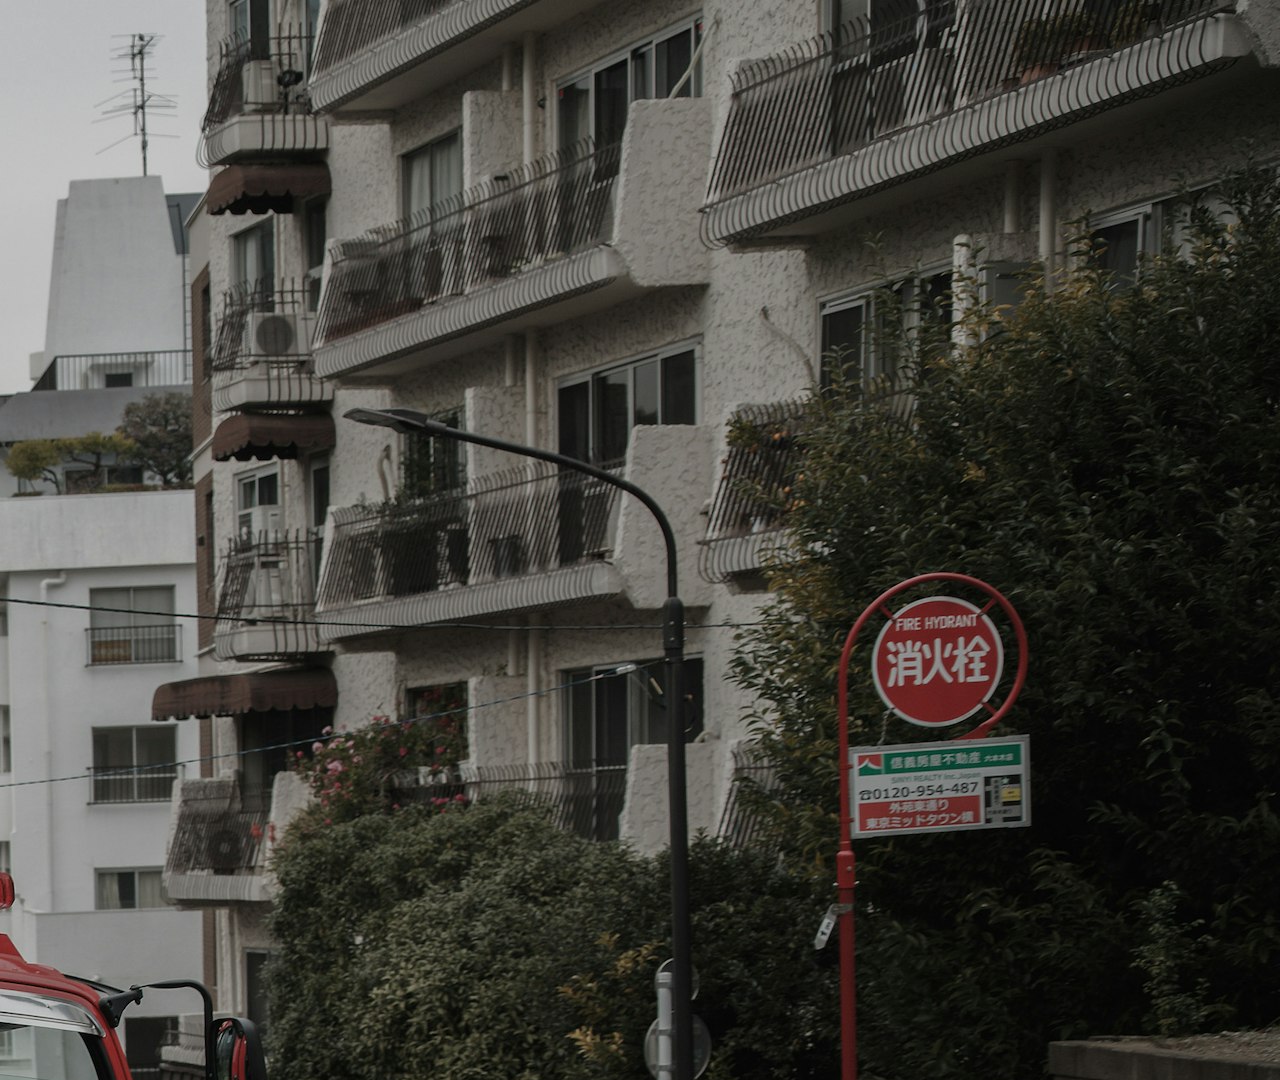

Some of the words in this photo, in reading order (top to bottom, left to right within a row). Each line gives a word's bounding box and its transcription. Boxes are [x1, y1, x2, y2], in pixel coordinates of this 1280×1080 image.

[895, 618, 922, 631] FIRE
[924, 614, 978, 630] HYDRANT
[886, 635, 991, 688] 消火栓
[873, 782, 979, 800] 0120-954-487
